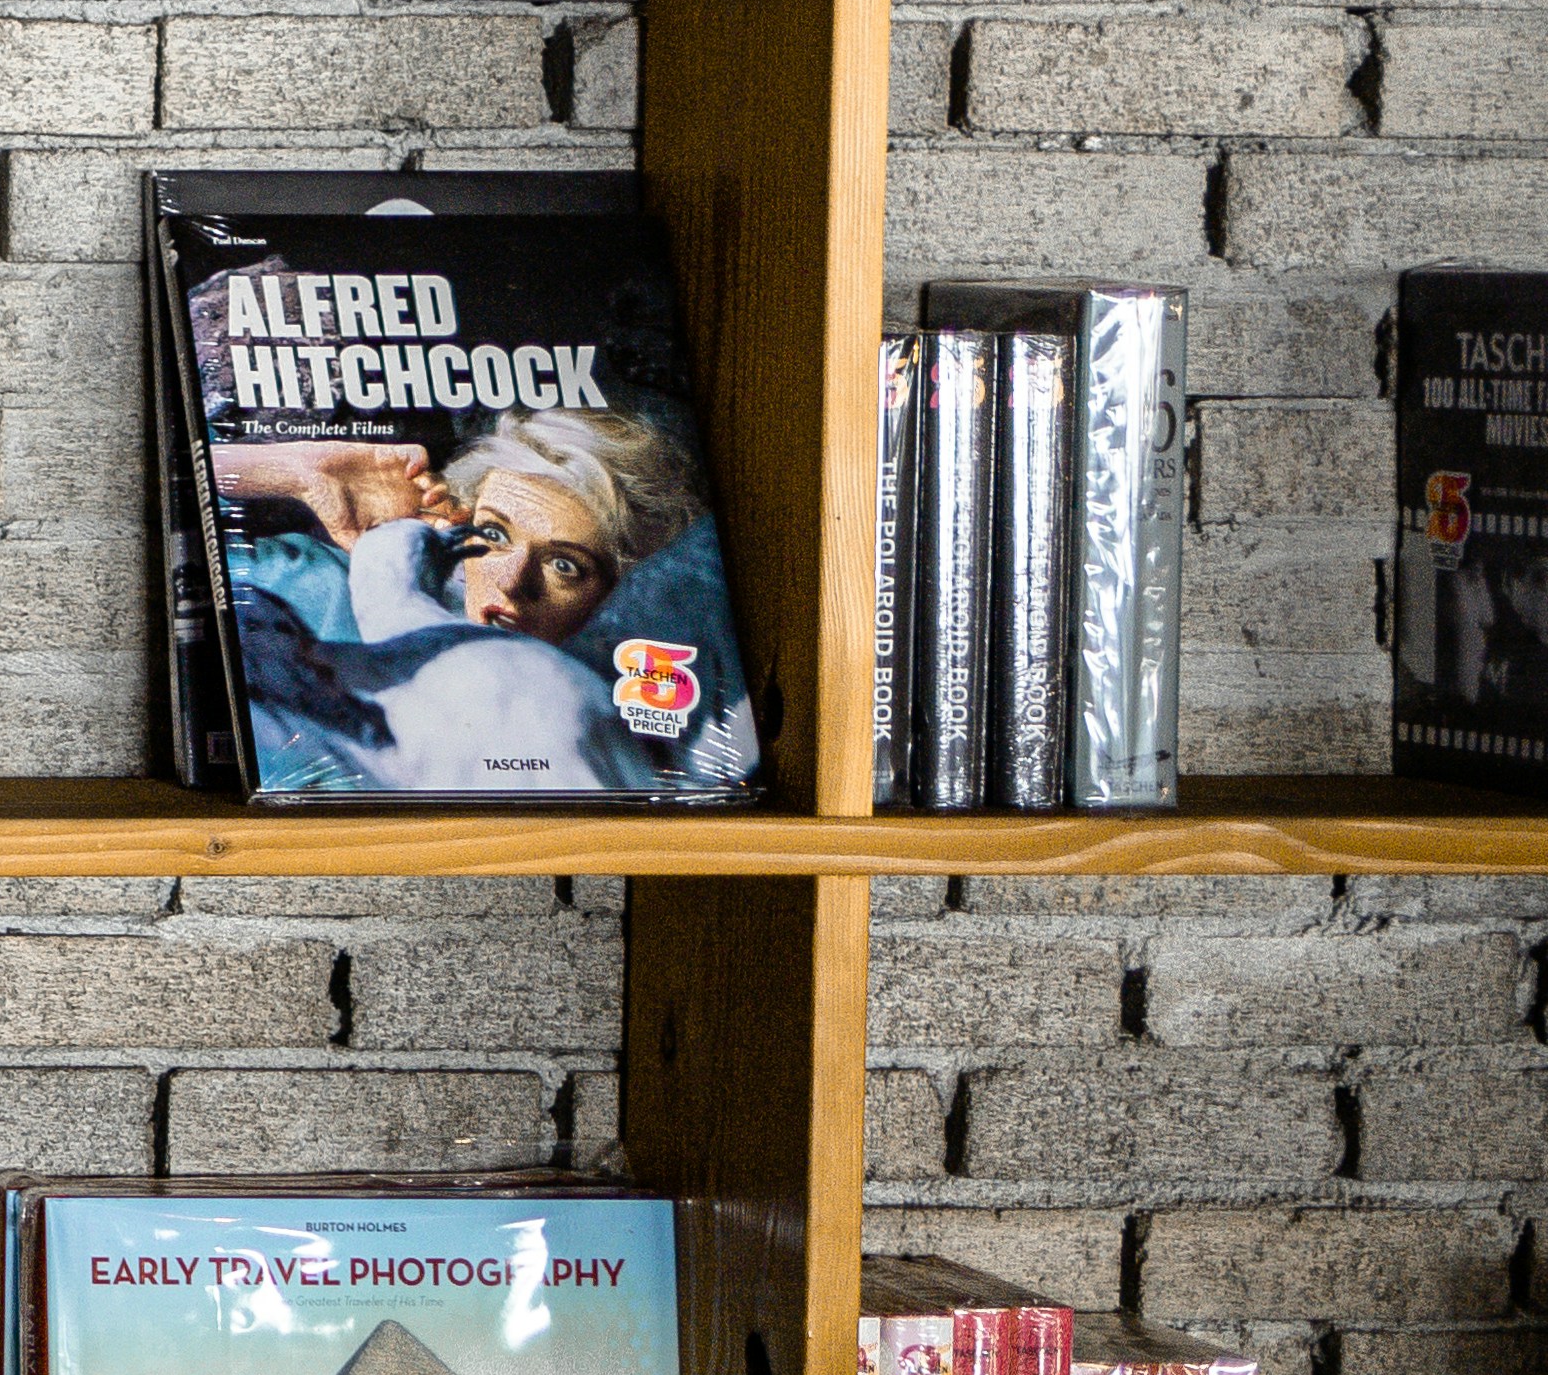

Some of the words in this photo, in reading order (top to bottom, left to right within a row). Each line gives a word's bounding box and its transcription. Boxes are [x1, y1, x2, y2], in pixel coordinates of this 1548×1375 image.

[212, 235, 231, 246] Paul
[233, 235, 267, 246] Duncan
[227, 274, 458, 338] ALFRED
[230, 344, 608, 410] HITCHCOCK
[242, 420, 270, 437] The
[275, 420, 347, 439] Complete
[352, 420, 395, 437] Films
[880, 461, 898, 512] THE
[874, 520, 897, 656] POLAROID
[626, 666, 689, 686] TASCHEN
[873, 665, 891, 743] BOOK
[626, 706, 683, 725] SPECIAL
[633, 718, 678, 736] PRICE!
[484, 758, 551, 772] TASCHEN
[306, 1222, 355, 1233] BURTON
[358, 1222, 407, 1233] HOLMES
[90, 1256, 200, 1286] EARLY
[213, 1256, 341, 1287] TRAVEL
